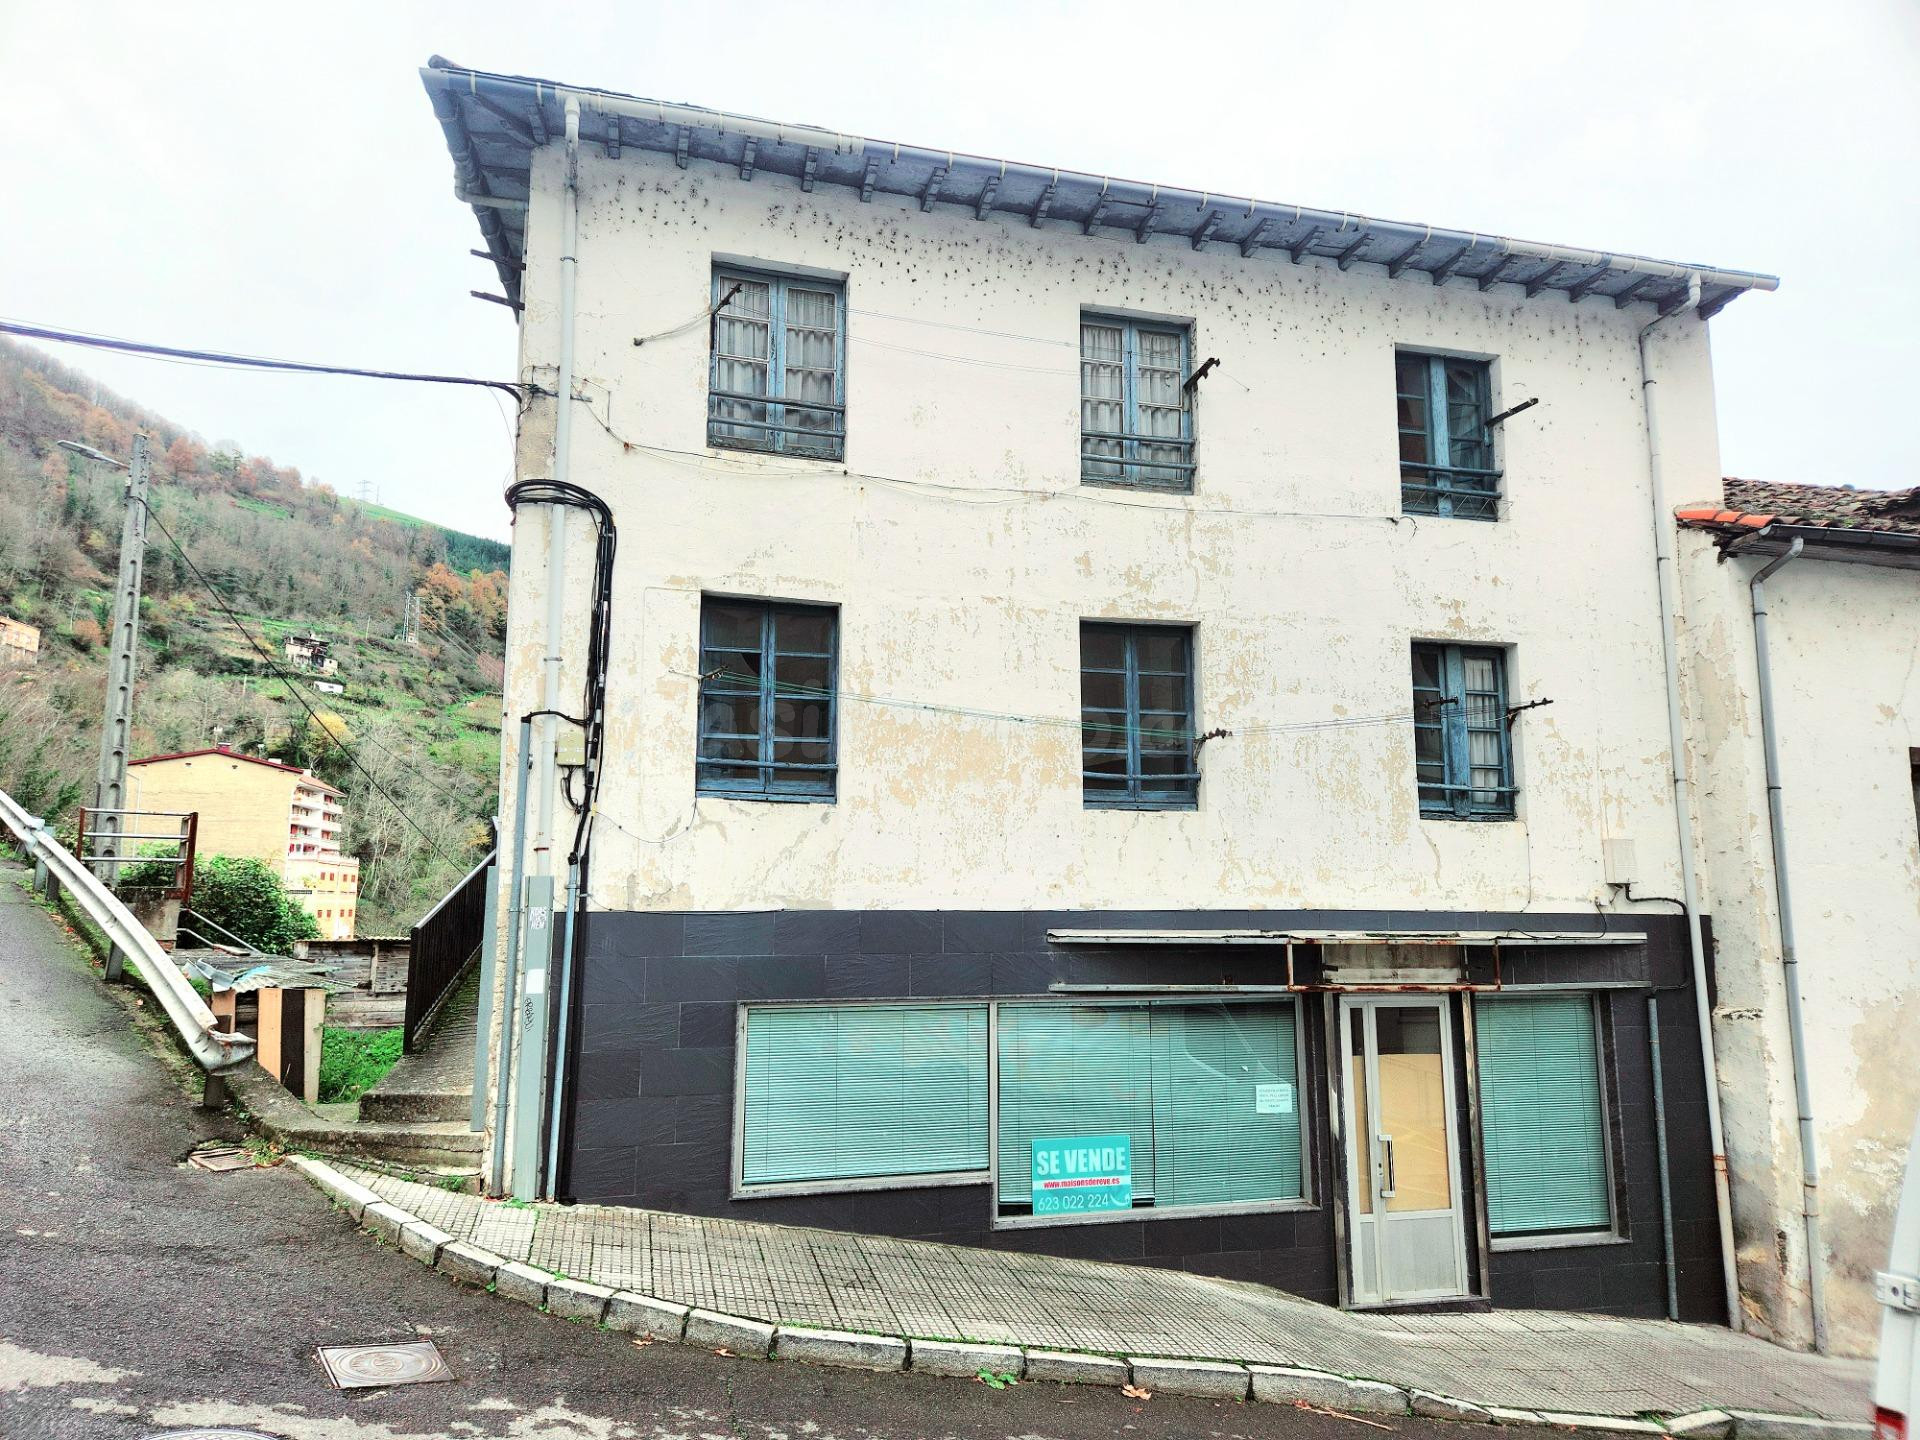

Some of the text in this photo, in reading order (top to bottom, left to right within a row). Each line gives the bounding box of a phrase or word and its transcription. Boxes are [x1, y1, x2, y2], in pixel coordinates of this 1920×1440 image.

[1037, 1147, 1126, 1175] SE VENDE
[1038, 1193, 1109, 1211] 623 022 224
